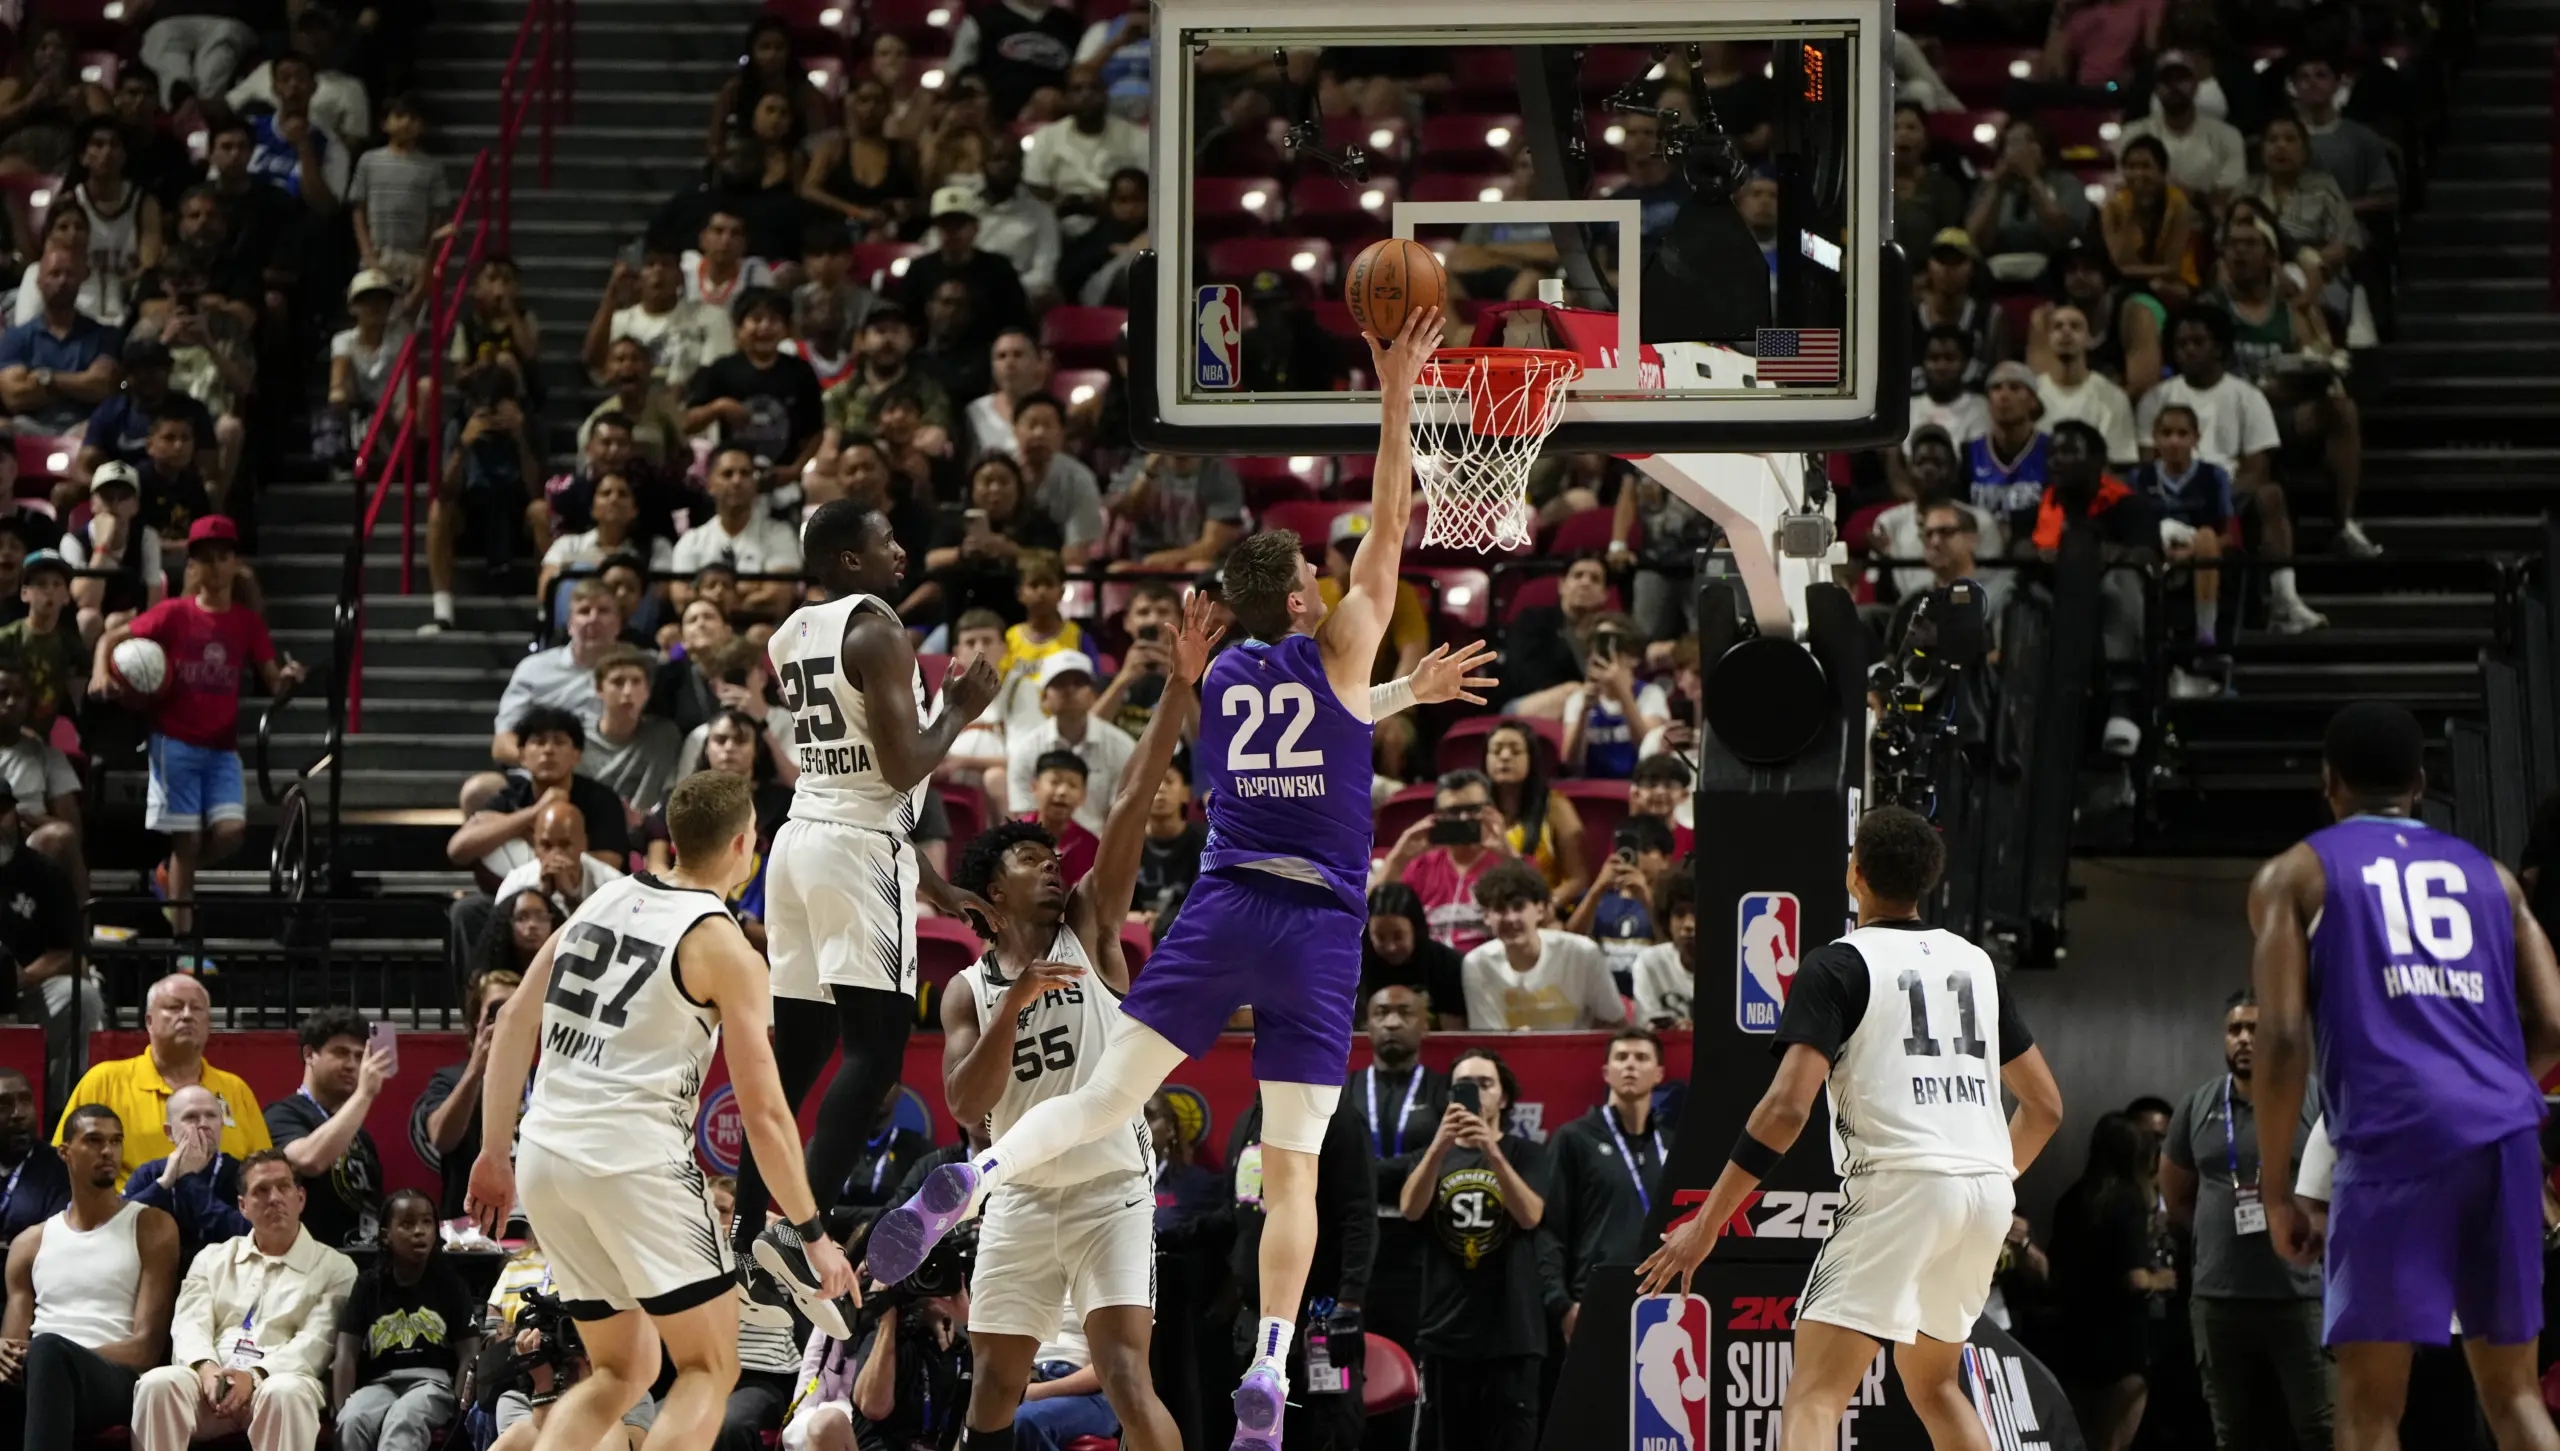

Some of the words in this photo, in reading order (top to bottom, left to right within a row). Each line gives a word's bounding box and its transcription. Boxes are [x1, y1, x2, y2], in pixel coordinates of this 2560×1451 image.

[1203, 365, 1224, 381] NBA
[780, 656, 847, 744] 25
[1222, 682, 1324, 771] 22
[2361, 856, 2473, 960] 16
[544, 921, 666, 1028] 27
[1746, 1002, 1776, 1025] NBA
[1897, 969, 1986, 1059] 11
[1012, 1024, 1075, 1082] 55
[1912, 1075, 1986, 1107] BRYANT
[1451, 1192, 1495, 1229] SL
